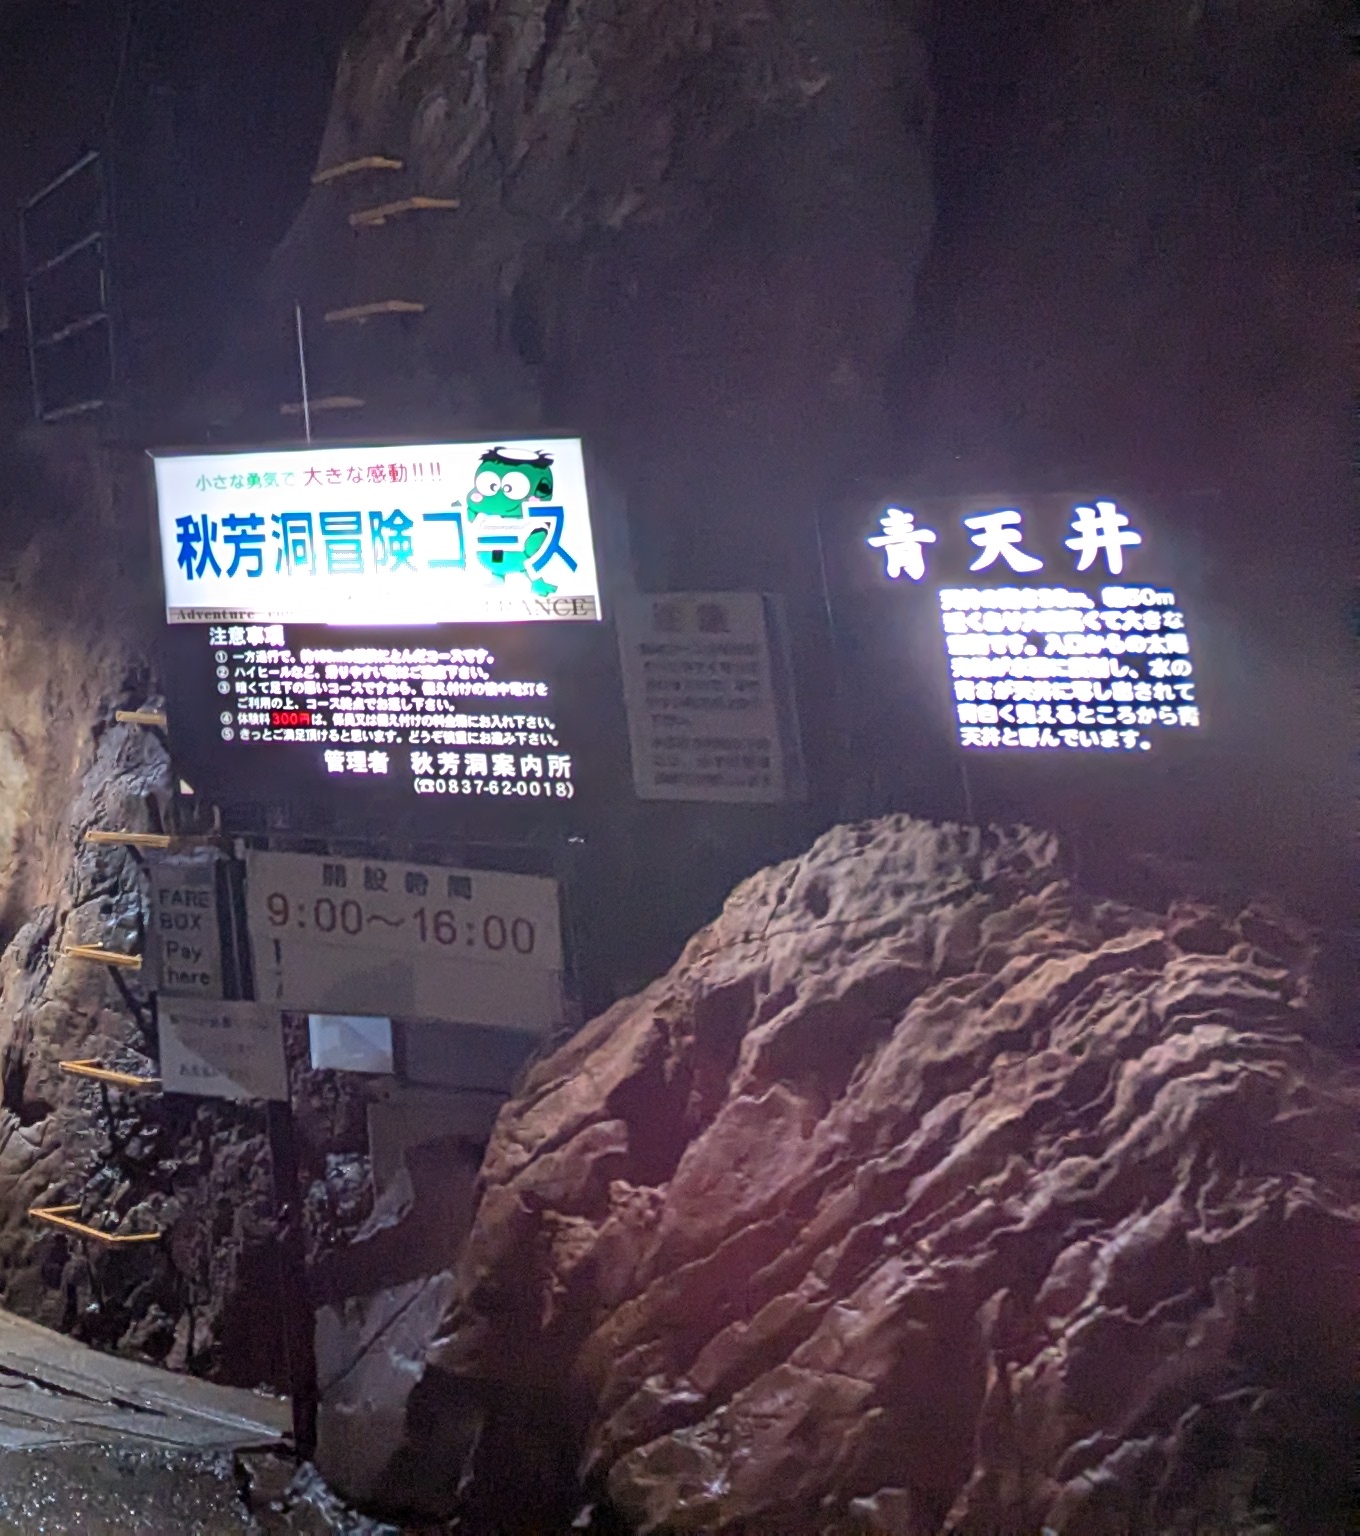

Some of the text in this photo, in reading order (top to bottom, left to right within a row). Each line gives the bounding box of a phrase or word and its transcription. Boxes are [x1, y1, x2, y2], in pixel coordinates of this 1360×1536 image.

[195, 471, 296, 492] 小さな勇気で
[174, 505, 578, 581] 秋芳洞冒険コース
[867, 501, 1142, 581] 青天井
[176, 608, 255, 621] Adventure
[324, 749, 572, 779] 管理者 秋芳洞案内所
[158, 889, 211, 909] FARE
[159, 912, 202, 931] BOX
[165, 940, 203, 964] Pay
[167, 966, 211, 986] here
